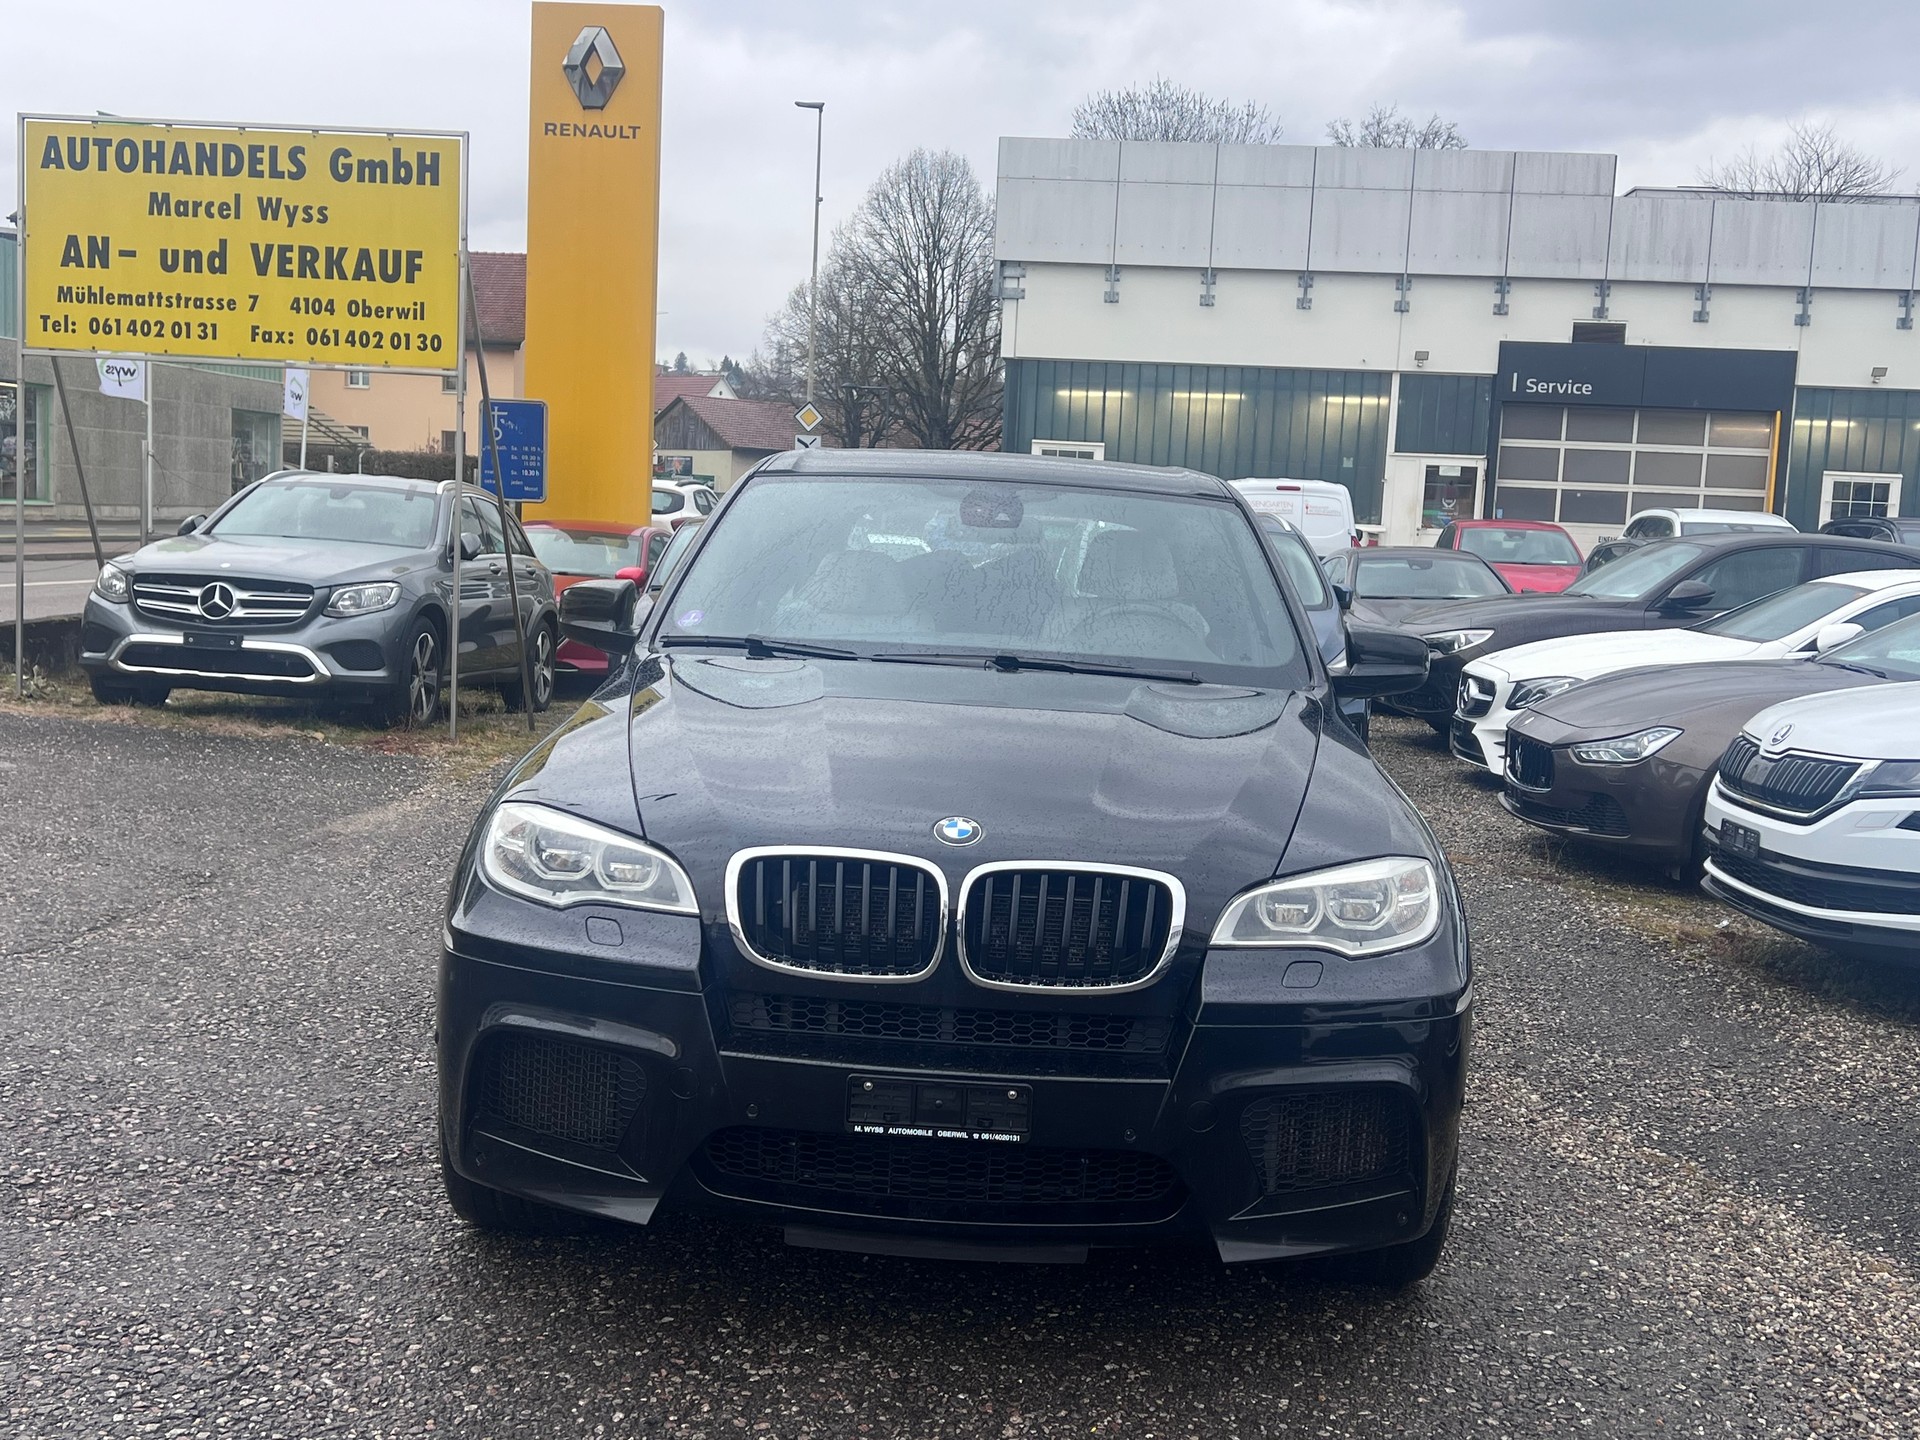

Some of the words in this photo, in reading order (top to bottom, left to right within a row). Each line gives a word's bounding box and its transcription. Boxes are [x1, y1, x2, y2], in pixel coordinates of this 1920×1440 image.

[544, 122, 641, 139] RENAULT
[40, 135, 307, 181] AUTOHANDELS
[329, 147, 440, 187] GmbH
[148, 191, 241, 220] Marcel
[257, 196, 329, 228] Wyss
[160, 238, 228, 275] und
[250, 242, 423, 284] VERKAUF
[57, 285, 237, 312] Mühlemattstrasse
[248, 294, 259, 312] 7
[290, 297, 335, 316] 4104
[347, 298, 426, 321] Oberwil
[40, 314, 77, 334] Tel:
[250, 325, 294, 345] Fax:
[1525, 378, 1593, 396] Service
[864, 1126, 884, 1134] WYSS
[888, 1127, 933, 1137] AUTOMOBILE
[937, 1130, 969, 1139] OBERWIL
[981, 1133, 1020, 1142] 061/4020131
